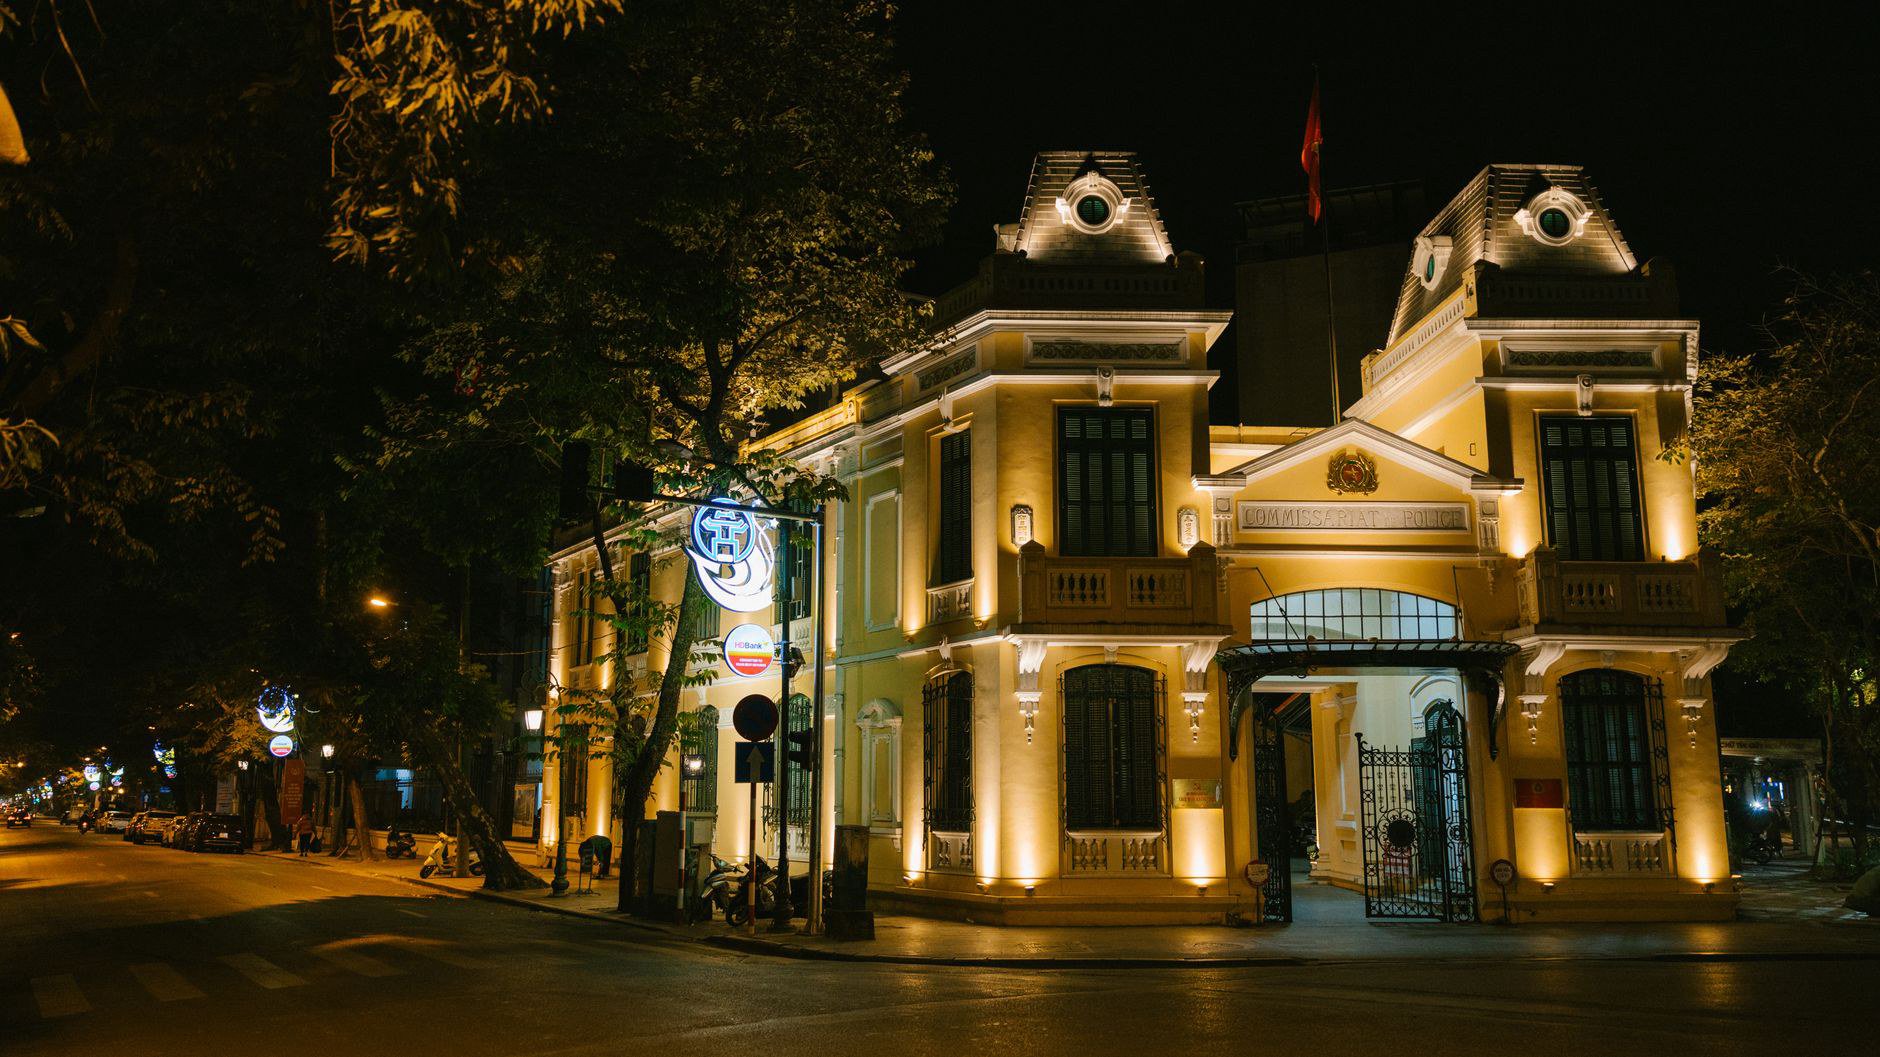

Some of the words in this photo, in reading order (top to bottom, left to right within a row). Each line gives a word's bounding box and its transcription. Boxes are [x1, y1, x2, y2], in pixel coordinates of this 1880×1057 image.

[1245, 508, 1380, 527] COMMISSARIAT
[1403, 510, 1461, 528] POLICE
[735, 641, 762, 649] HDBank
